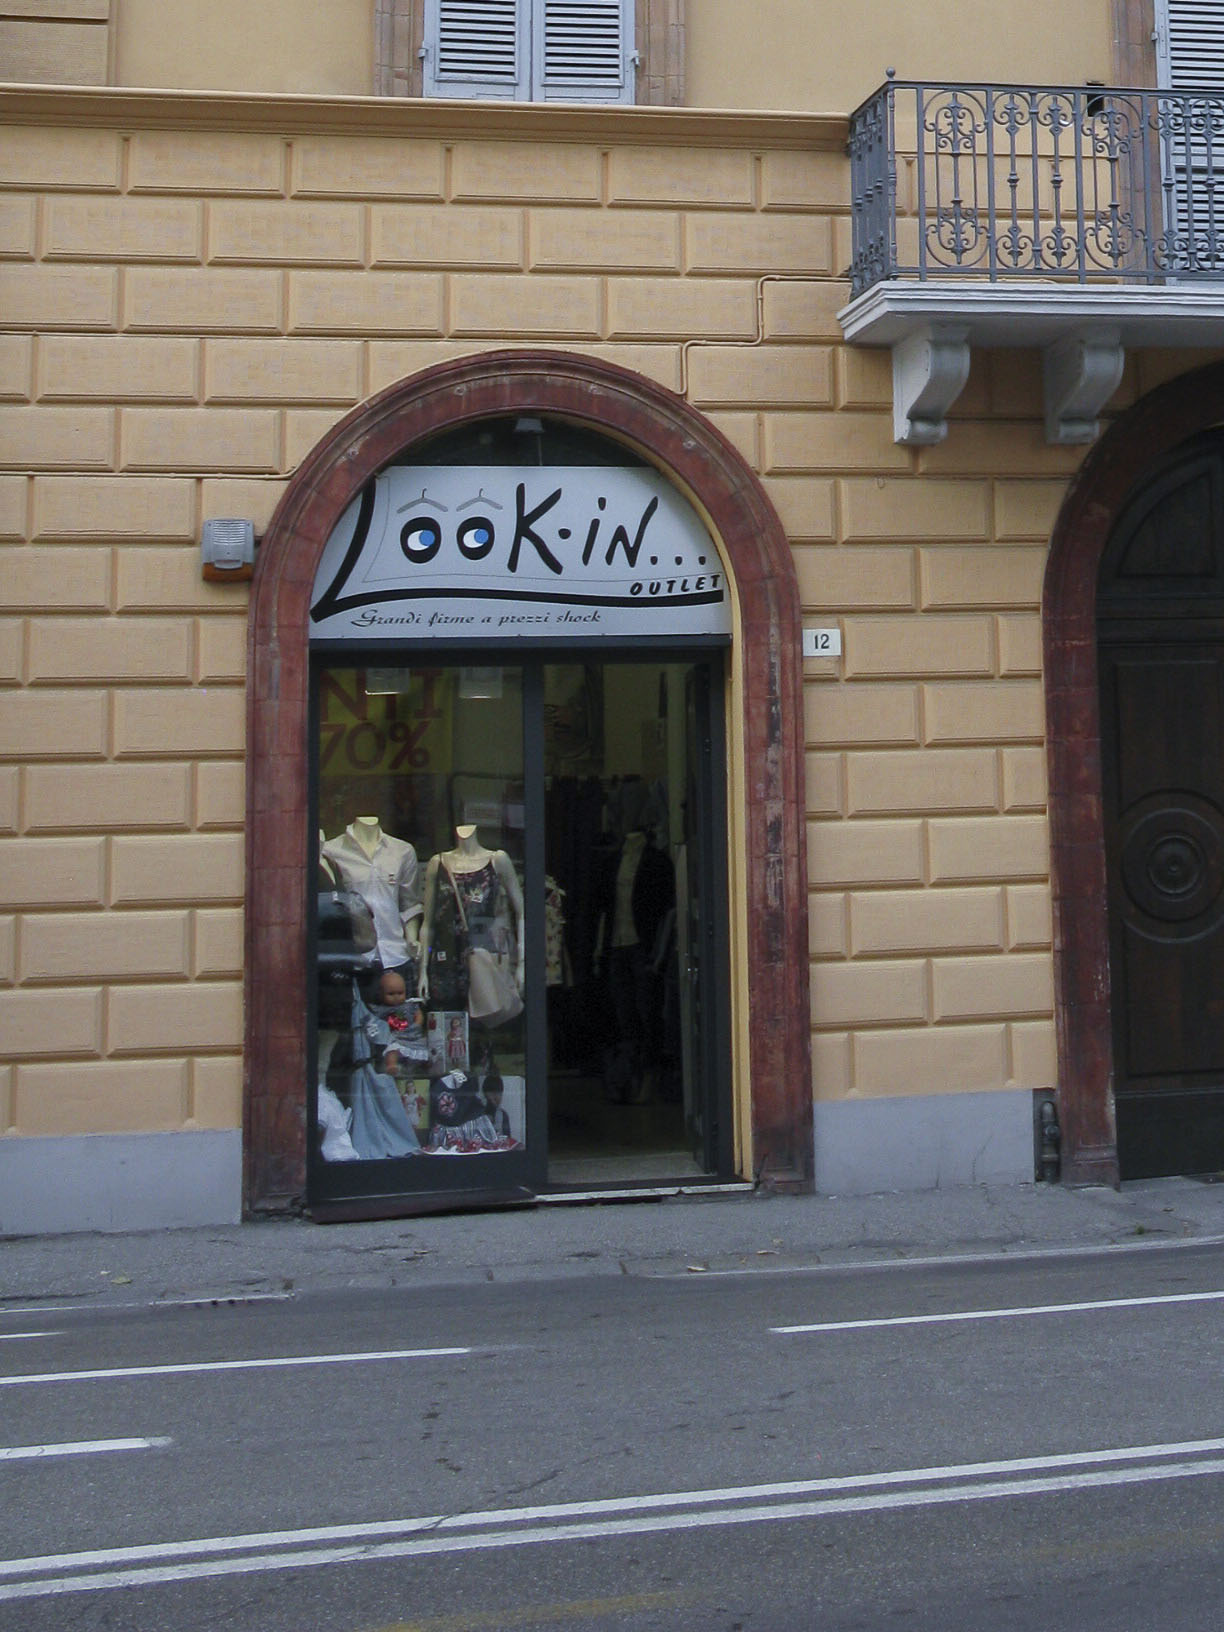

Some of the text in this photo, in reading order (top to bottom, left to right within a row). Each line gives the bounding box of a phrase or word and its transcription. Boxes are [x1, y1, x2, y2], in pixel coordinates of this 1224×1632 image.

[630, 574, 721, 596] OUTLET
[351, 609, 601, 628] Grandi firme a prezzi shock
[814, 633, 829, 649] 12
